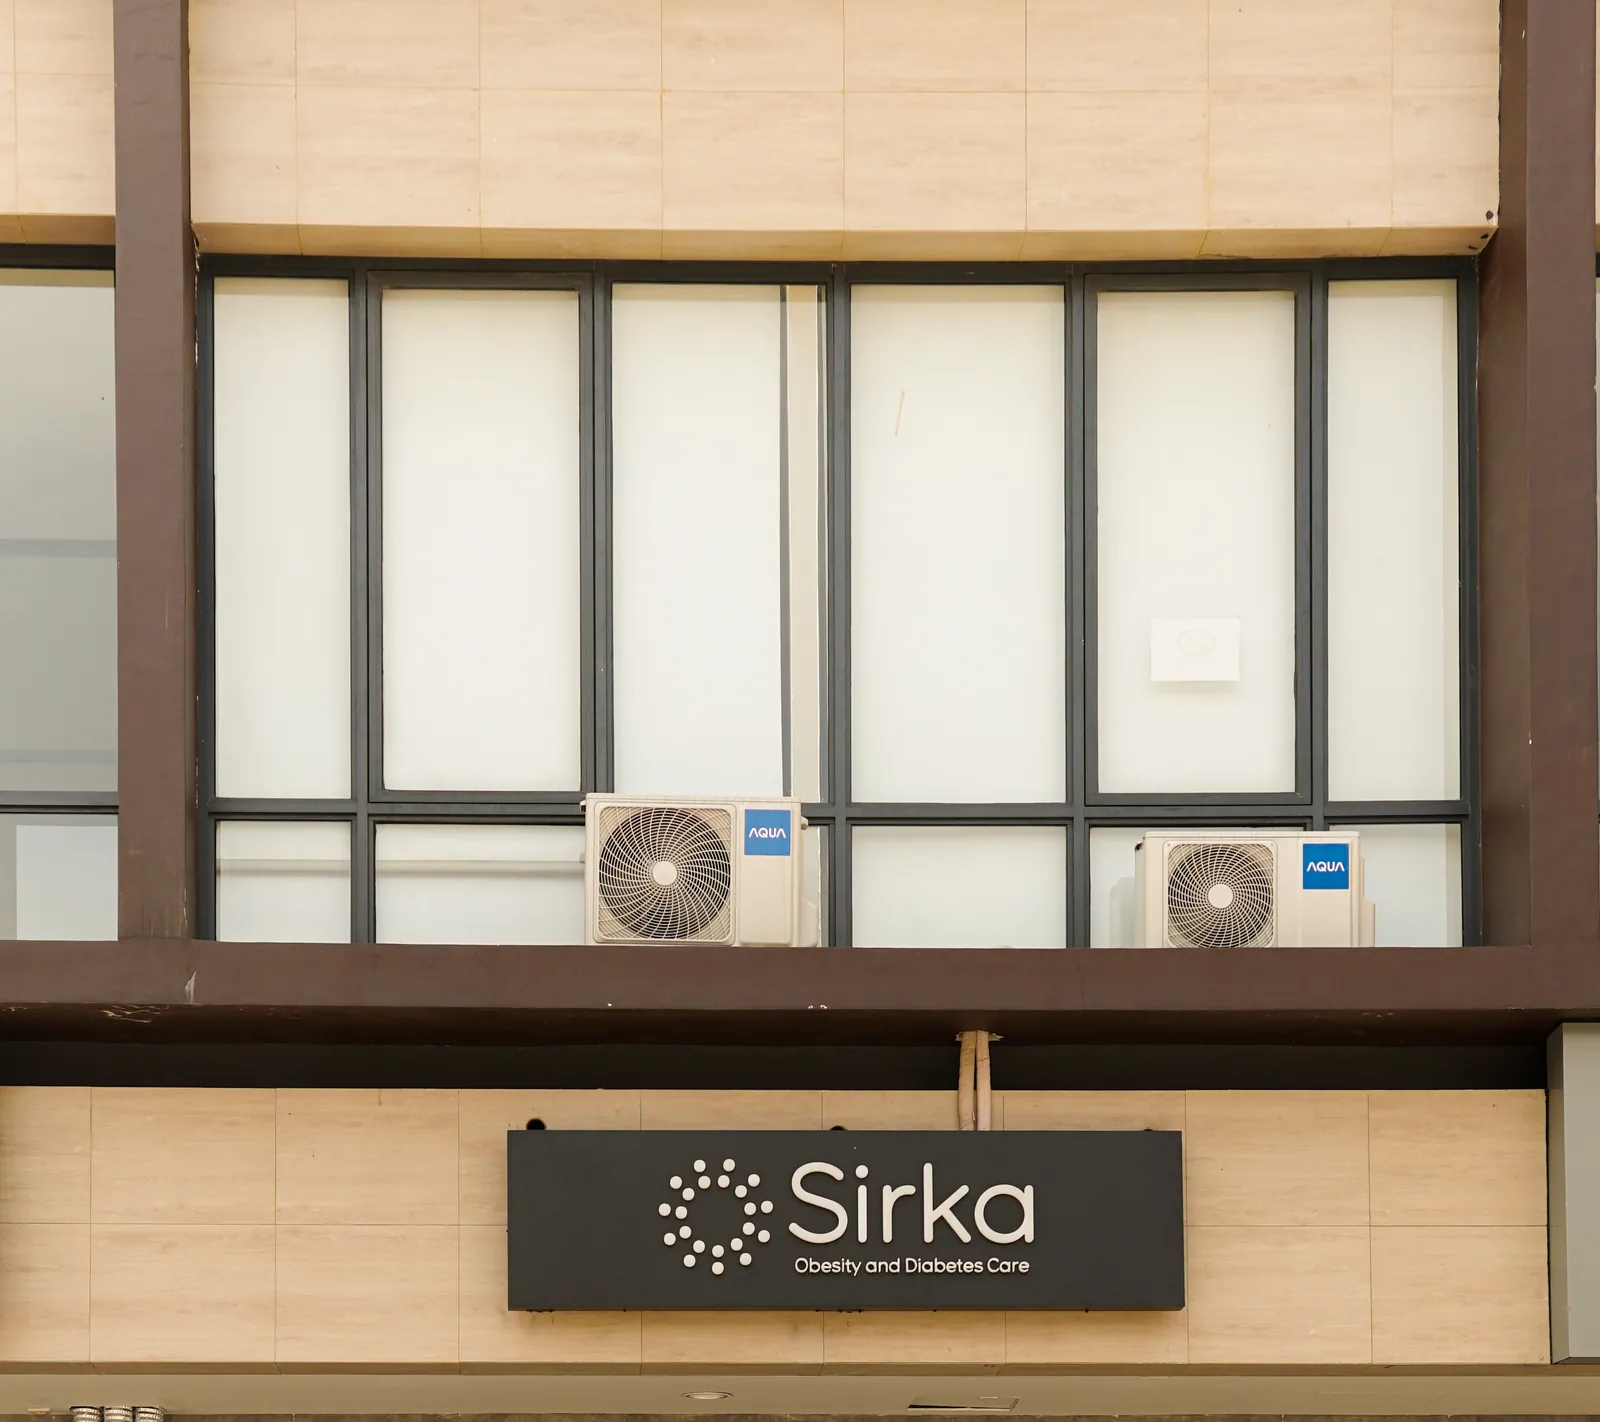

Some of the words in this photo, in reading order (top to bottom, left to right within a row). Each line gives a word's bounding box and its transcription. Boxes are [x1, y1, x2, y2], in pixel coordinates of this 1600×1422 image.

[748, 827, 787, 838] AQUA
[1306, 861, 1345, 872] AQUA
[788, 1161, 1035, 1244] Sirka
[794, 1257, 862, 1277] Obesity
[865, 1257, 900, 1274] and
[905, 1257, 984, 1274] Diabetes
[987, 1257, 1031, 1274] Care
